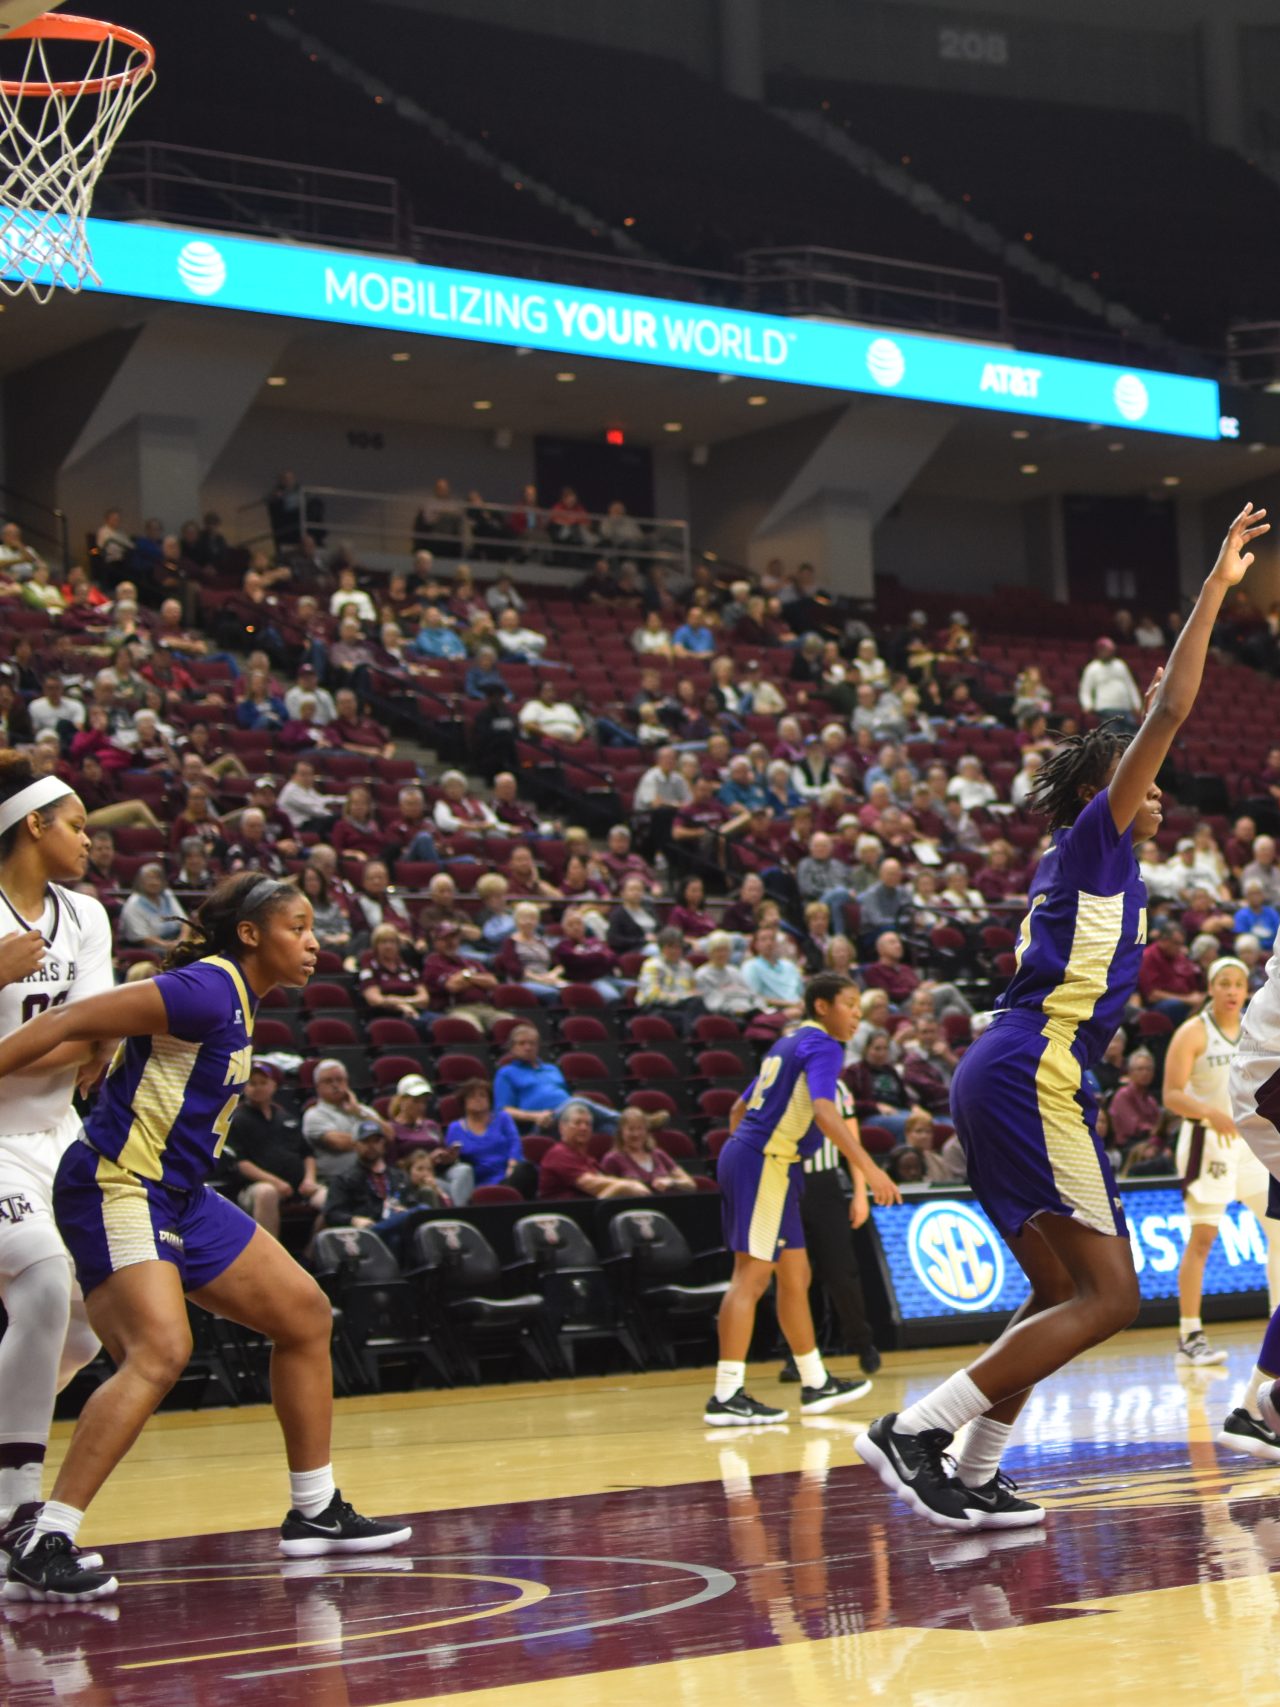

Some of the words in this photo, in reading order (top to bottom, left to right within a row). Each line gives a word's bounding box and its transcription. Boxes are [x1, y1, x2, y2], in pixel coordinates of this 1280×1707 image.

[324, 267, 549, 334] MOBILIZING
[554, 299, 658, 349] YOUR
[979, 362, 1043, 399] AT&T
[917, 1212, 996, 1301] SEC
